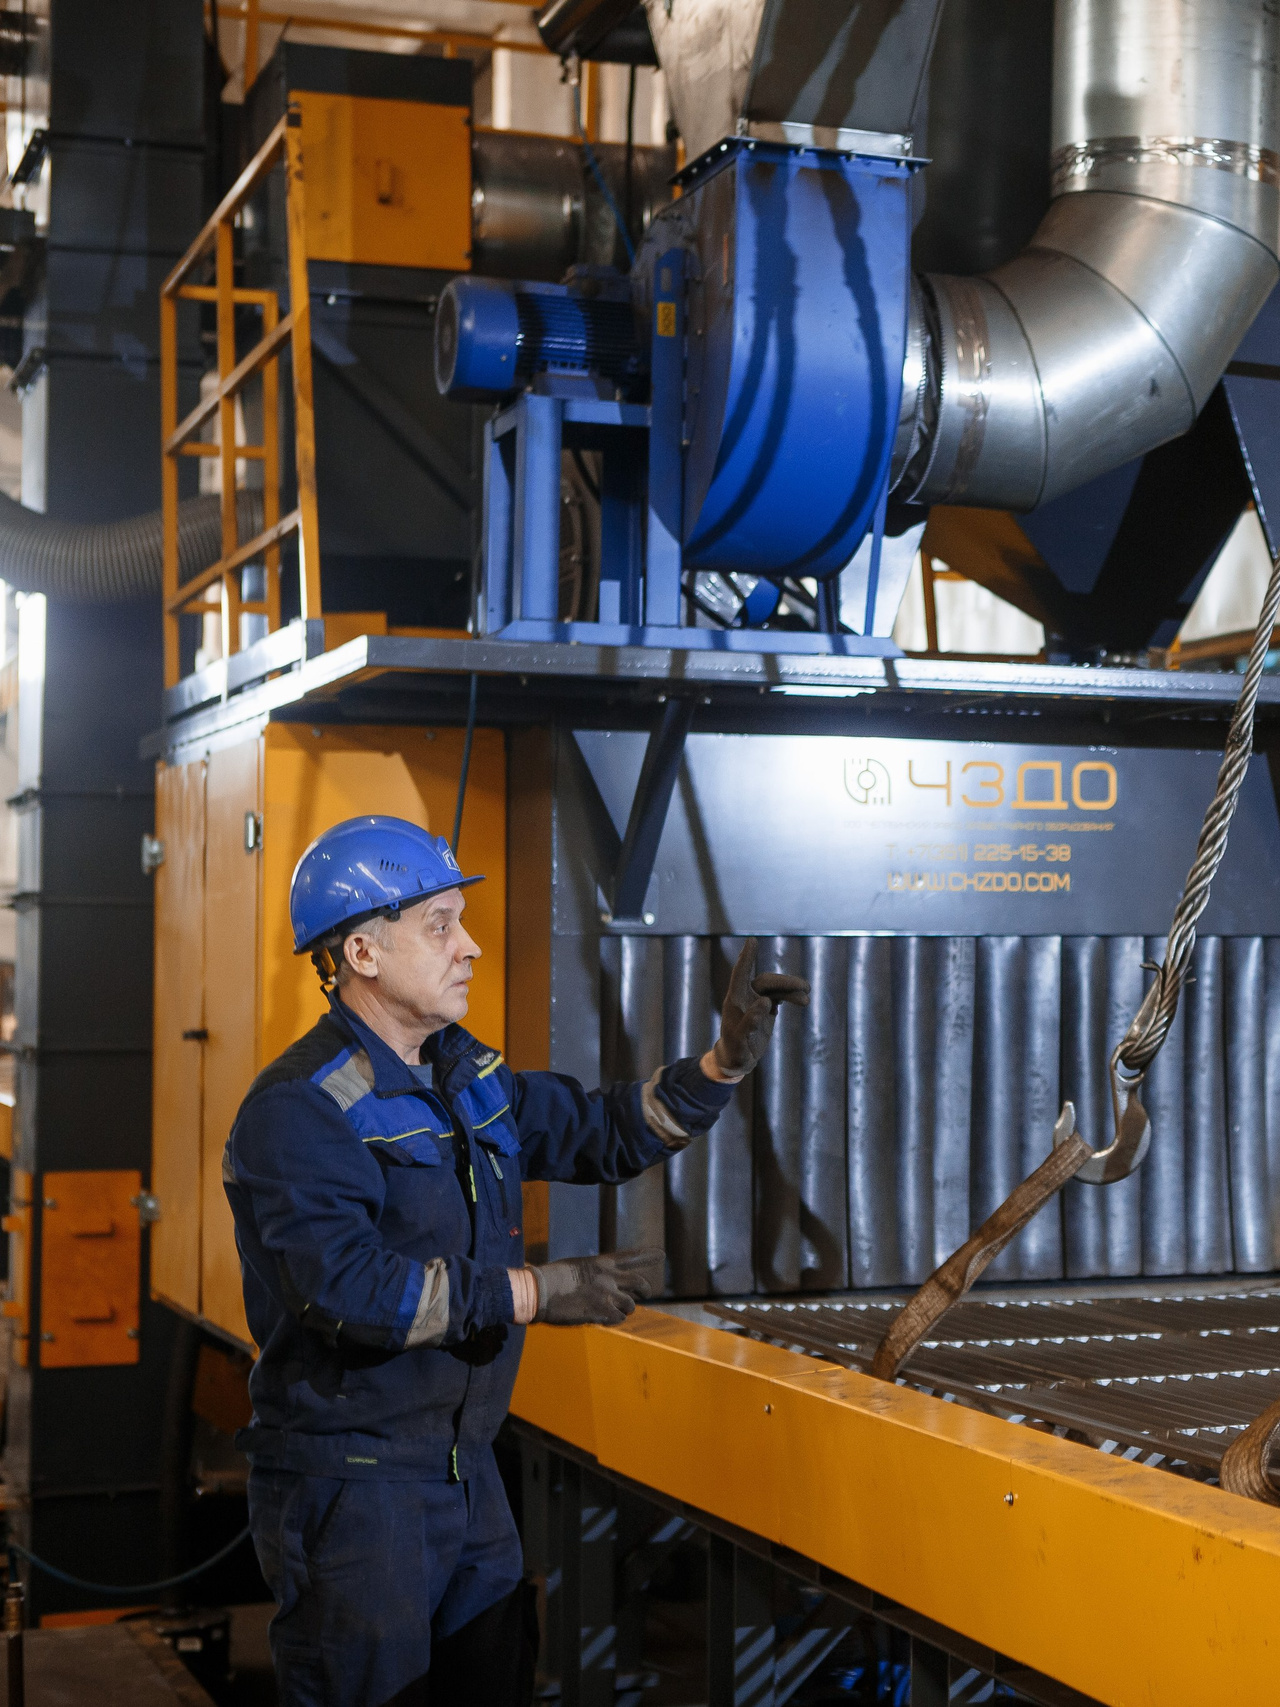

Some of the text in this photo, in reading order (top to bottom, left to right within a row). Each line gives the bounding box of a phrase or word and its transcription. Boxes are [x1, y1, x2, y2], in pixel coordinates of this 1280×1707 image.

[908, 759, 1118, 811] ЧЗДО
[974, 843, 1071, 862] 225-15-38
[887, 871, 1071, 892] WWW.CHZDO.COM
